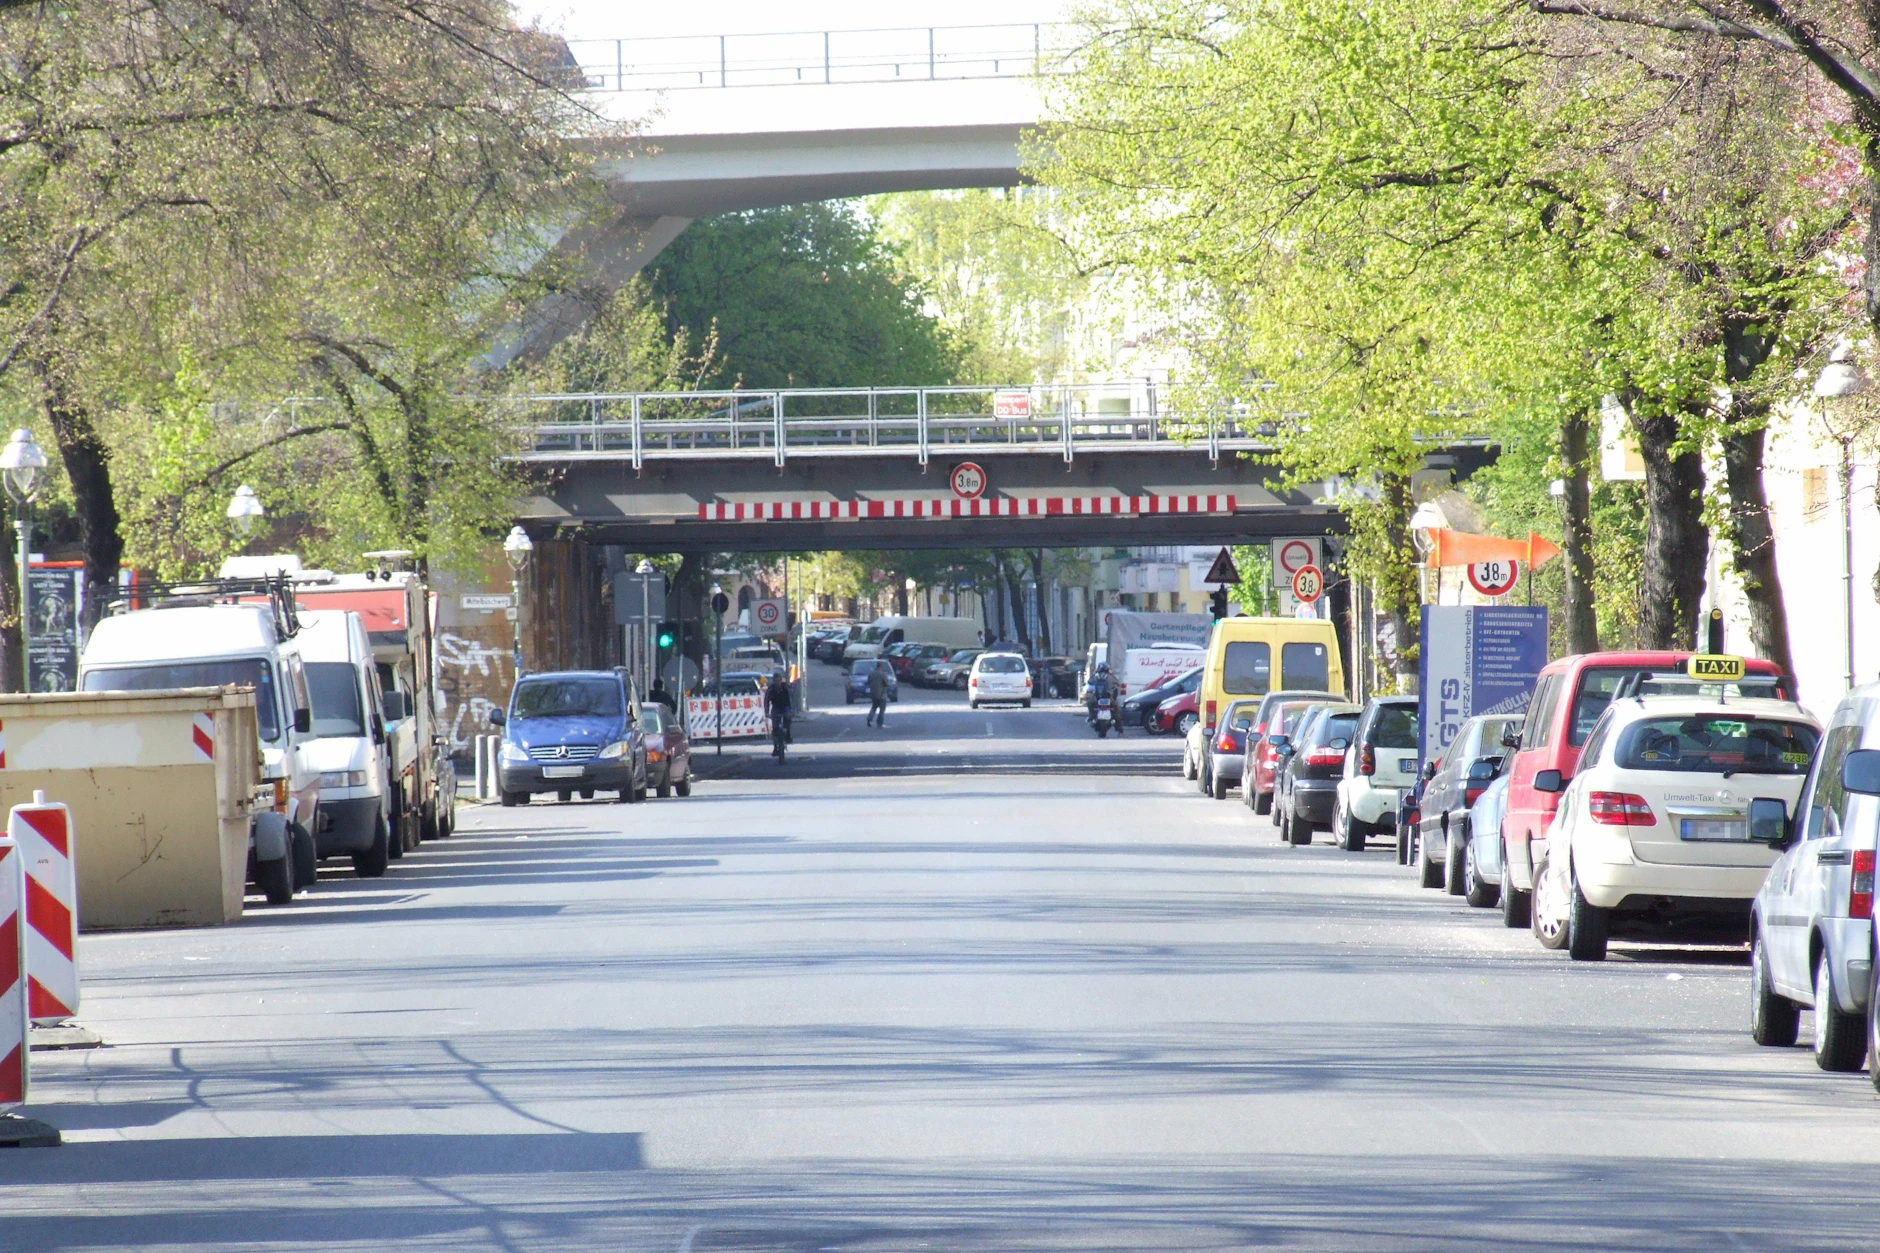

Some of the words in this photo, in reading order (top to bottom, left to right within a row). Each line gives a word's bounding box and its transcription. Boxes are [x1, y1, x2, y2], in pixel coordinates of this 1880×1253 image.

[762, 608, 775, 618] 30
[1150, 622, 1207, 633] Gartenpflege
[1698, 660, 1736, 674] TAXI
[1440, 678, 1460, 747] GTS
[1783, 753, 1808, 763] 4238
[1664, 793, 1714, 802] Umwelt-Taxi
